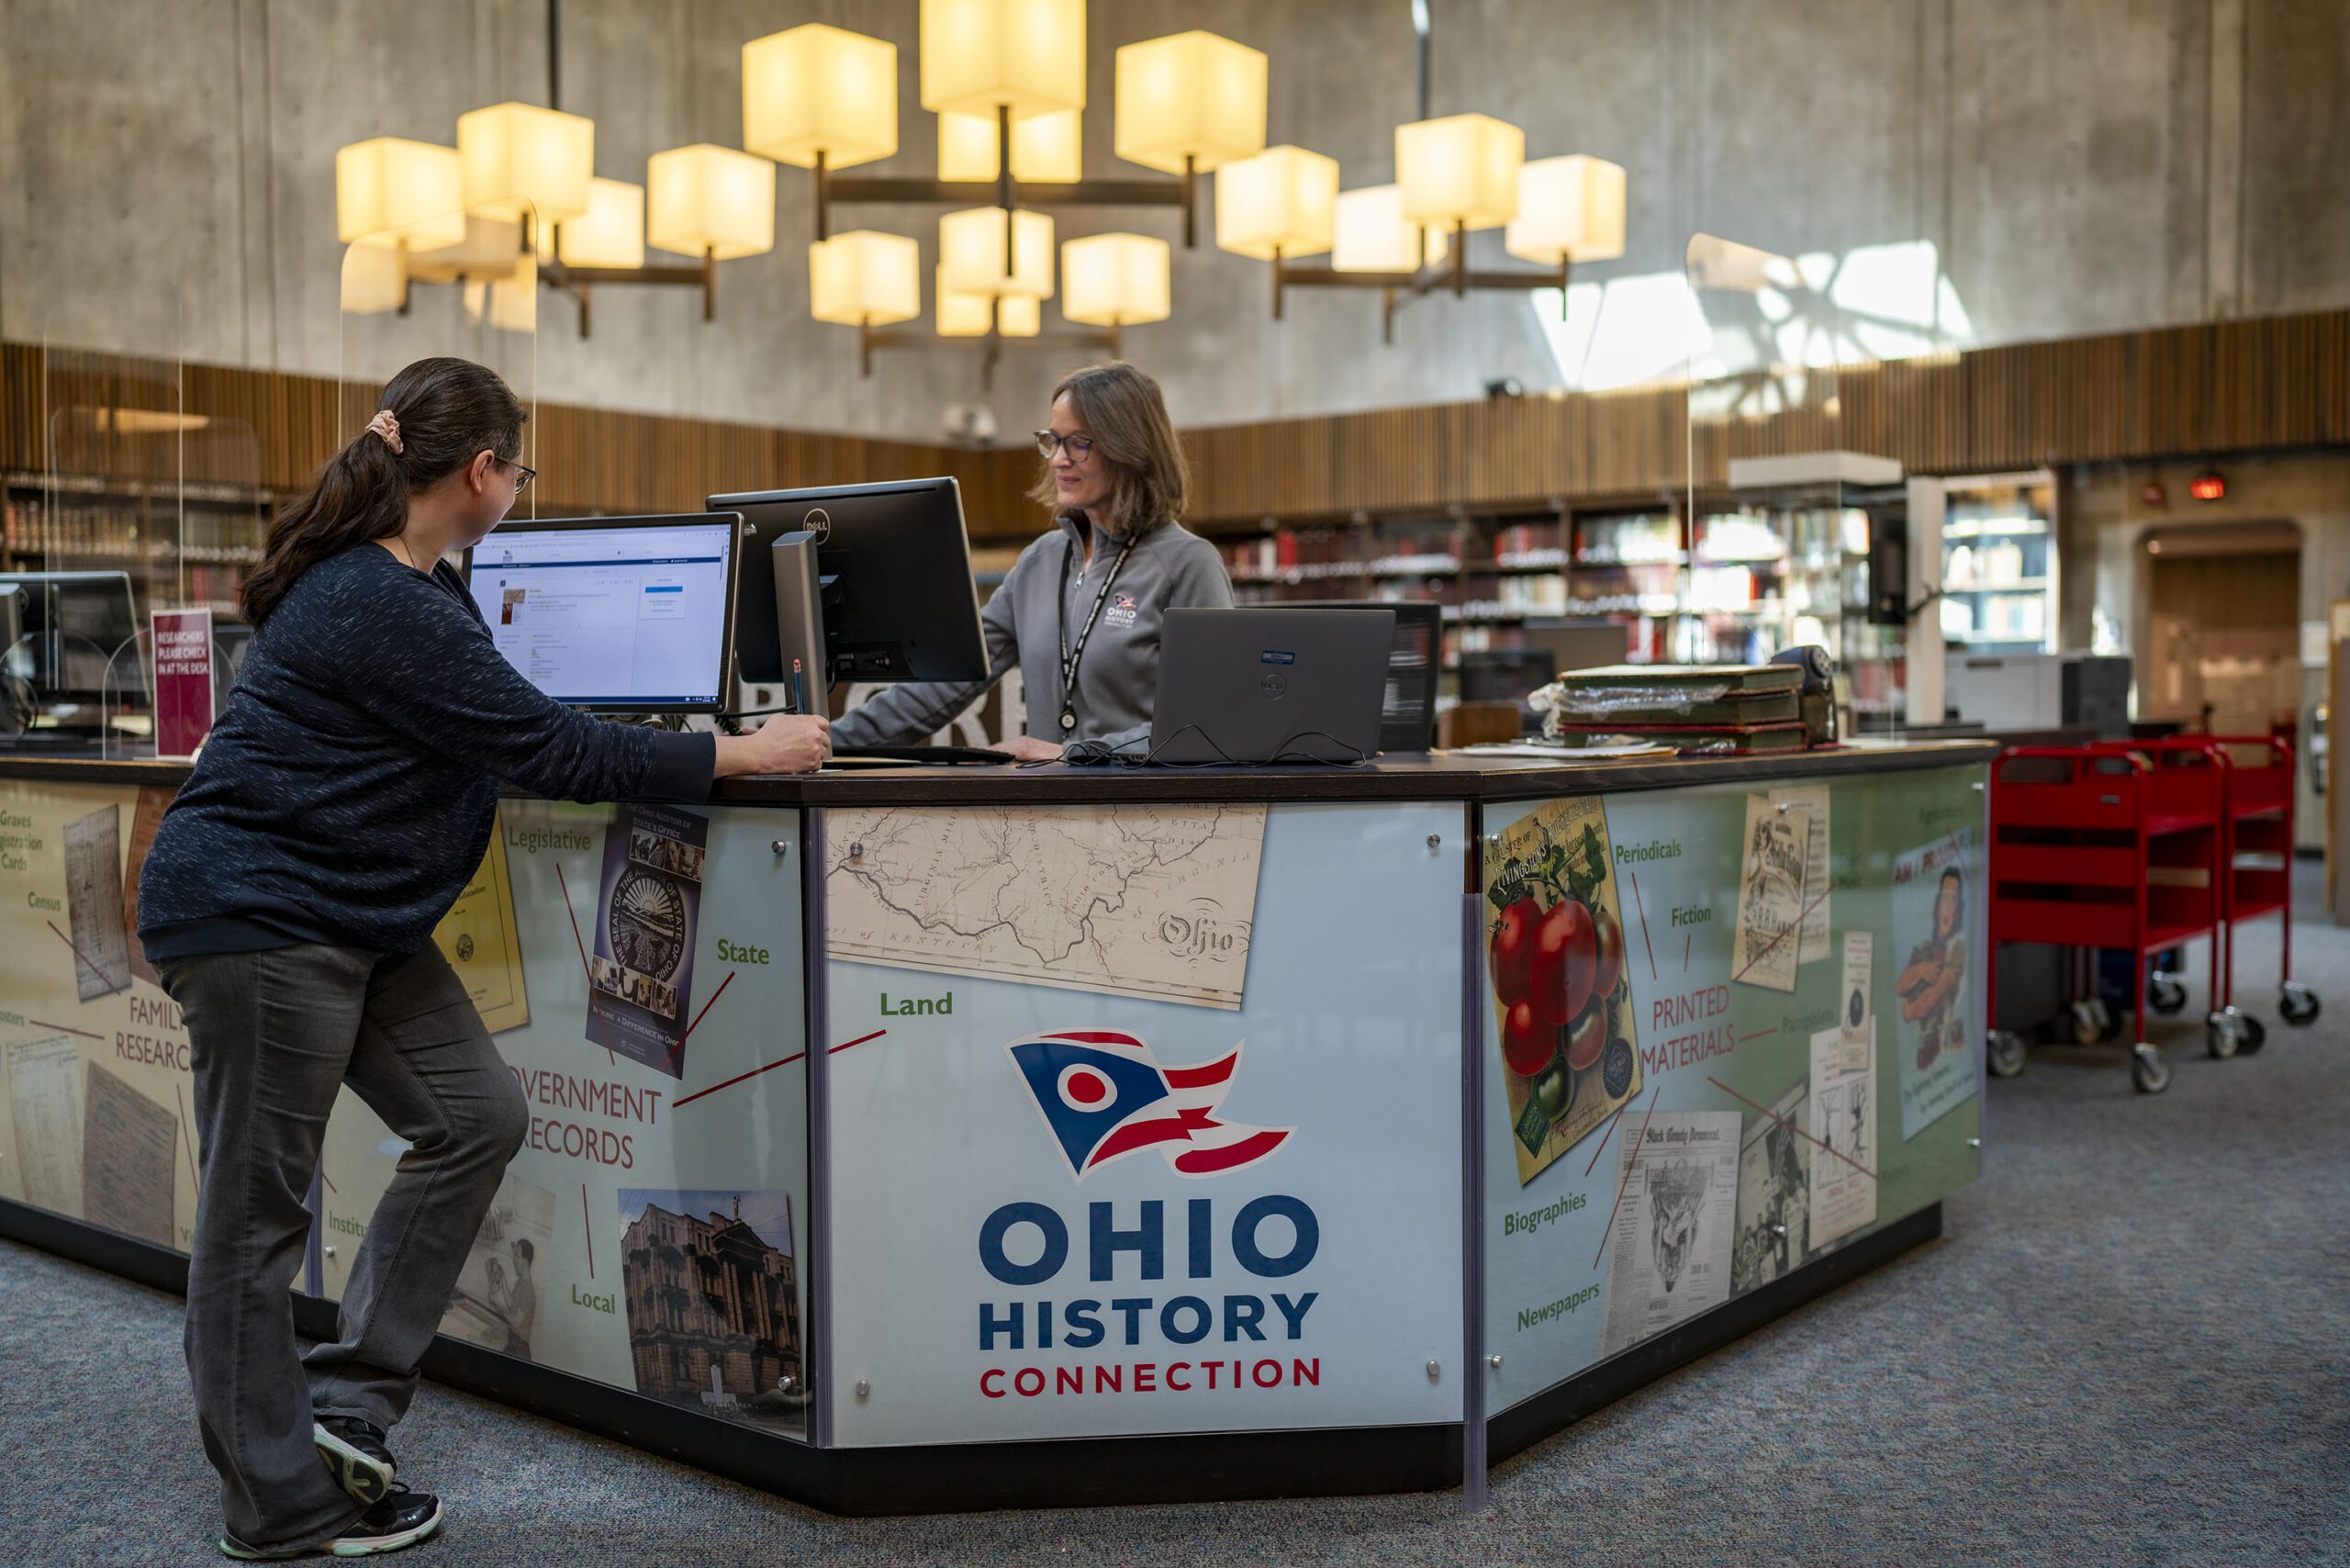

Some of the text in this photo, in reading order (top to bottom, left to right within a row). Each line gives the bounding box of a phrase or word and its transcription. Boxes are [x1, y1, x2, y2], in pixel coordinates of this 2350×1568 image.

[807, 521, 828, 532] DELL
[1107, 607, 1137, 620] OHIO
[158, 645, 207, 660] PLEASE CHECK
[190, 661, 209, 676] DESK
[0, 810, 31, 828] Graves
[638, 807, 655, 818] OHIO
[655, 811, 683, 828] AUDITOR
[0, 834, 43, 852] gistration
[509, 826, 592, 854] Legislative
[657, 823, 683, 840] OFFICE
[1484, 855, 1492, 865] A
[1523, 830, 1532, 843] OF
[1616, 838, 1682, 865] Periodicals
[2, 853, 28, 870] Cards
[28, 891, 62, 912] Census
[614, 890, 624, 908] OF
[612, 911, 621, 943] SEAL
[672, 900, 685, 942] STATE
[1672, 904, 1711, 927] Fiction
[717, 938, 770, 965] State
[655, 961, 674, 981] OHIO
[880, 992, 953, 1016] Land
[1653, 984, 1729, 1031] PRINTED
[0, 1011, 25, 1027] osters
[117, 1032, 190, 1072] RESEARC
[1641, 1024, 1734, 1078] MATERIALS
[509, 1066, 662, 1125] VERNMENT
[525, 1116, 633, 1169] ECORDS
[329, 1211, 368, 1238] Institu
[1505, 1192, 1587, 1237] Biographies
[979, 1194, 1320, 1285] OHIO
[572, 1283, 616, 1315] Local
[1517, 1283, 1600, 1332] Newspapers
[979, 1293, 1320, 1350] HISTORY
[979, 1358, 1320, 1398] CONNECTION
